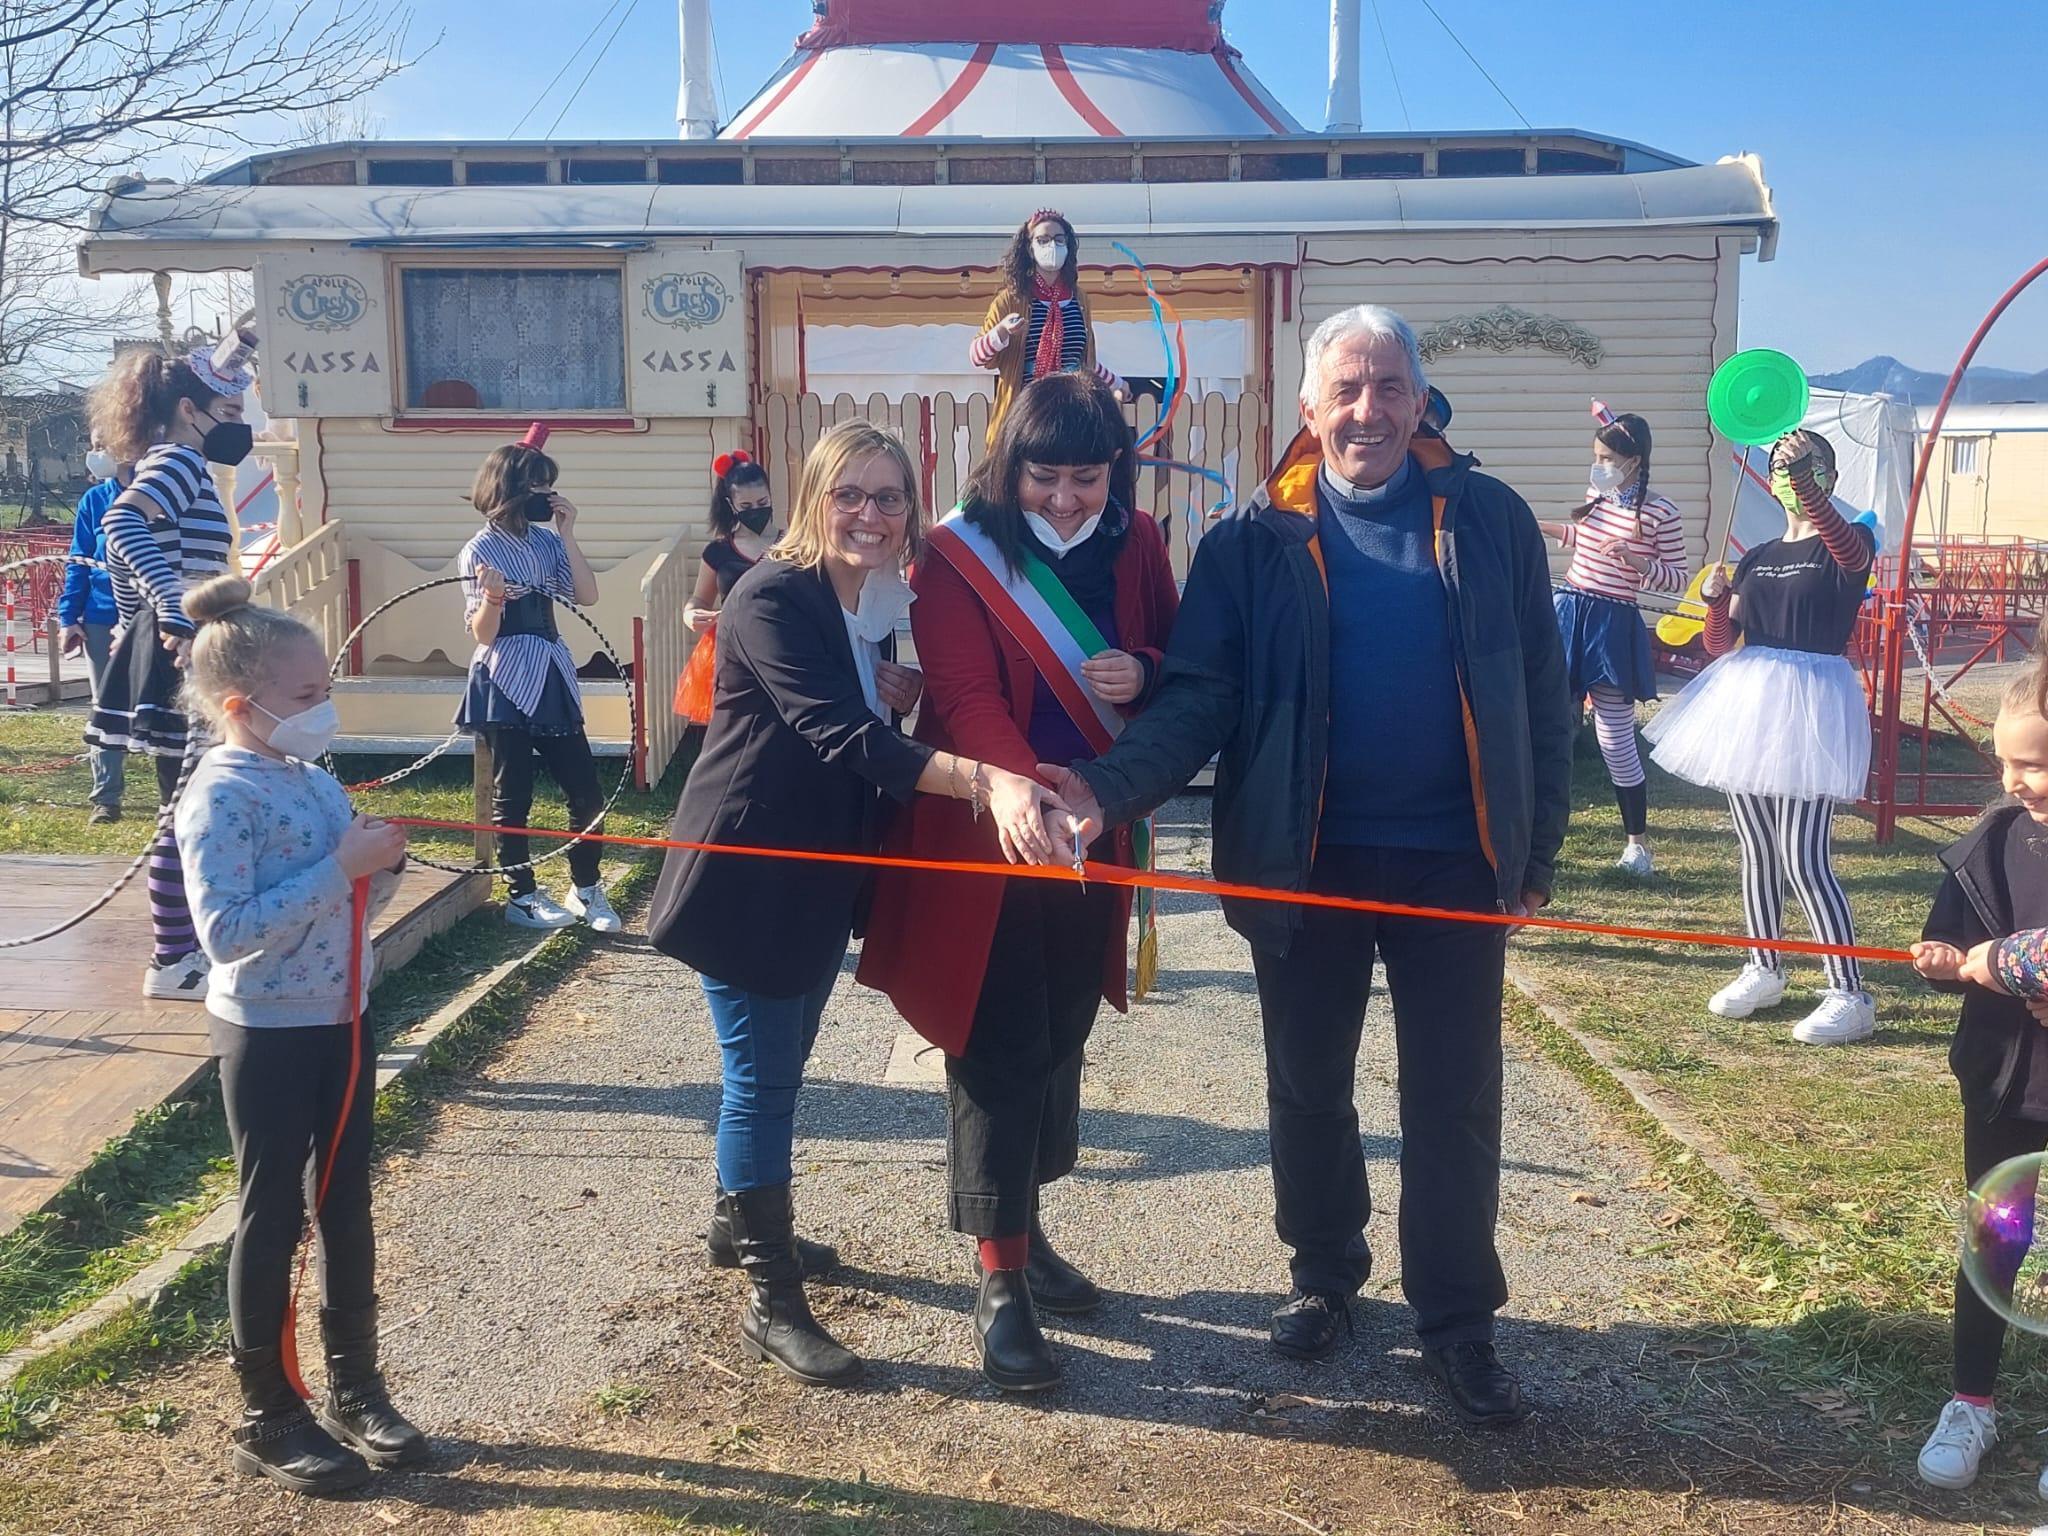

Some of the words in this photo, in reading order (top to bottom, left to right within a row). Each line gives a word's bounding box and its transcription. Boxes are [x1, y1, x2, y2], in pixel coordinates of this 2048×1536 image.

[311, 278, 349, 288] APOLLO
[672, 276, 709, 286] APOLLO
[283, 351, 381, 373] CASSA
[642, 349, 736, 373] CASSA
